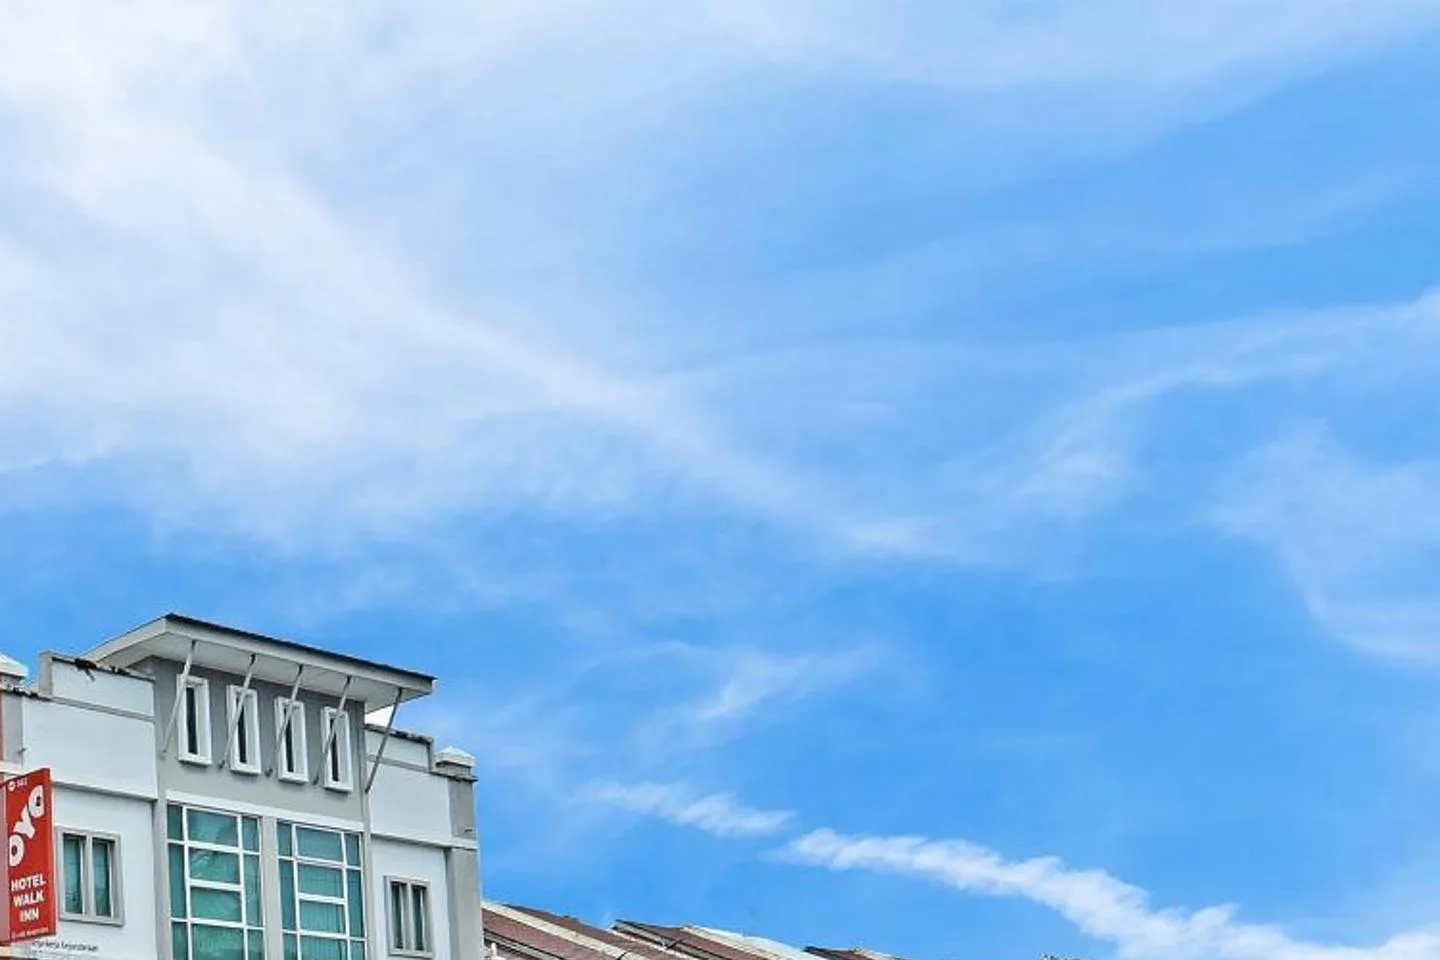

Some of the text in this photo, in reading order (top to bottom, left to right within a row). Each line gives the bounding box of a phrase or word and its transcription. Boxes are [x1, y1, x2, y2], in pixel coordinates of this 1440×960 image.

[9, 784, 46, 868] OYO
[11, 873, 46, 891] HOTEL
[13, 893, 45, 907] WALK
[19, 907, 40, 922] INN
